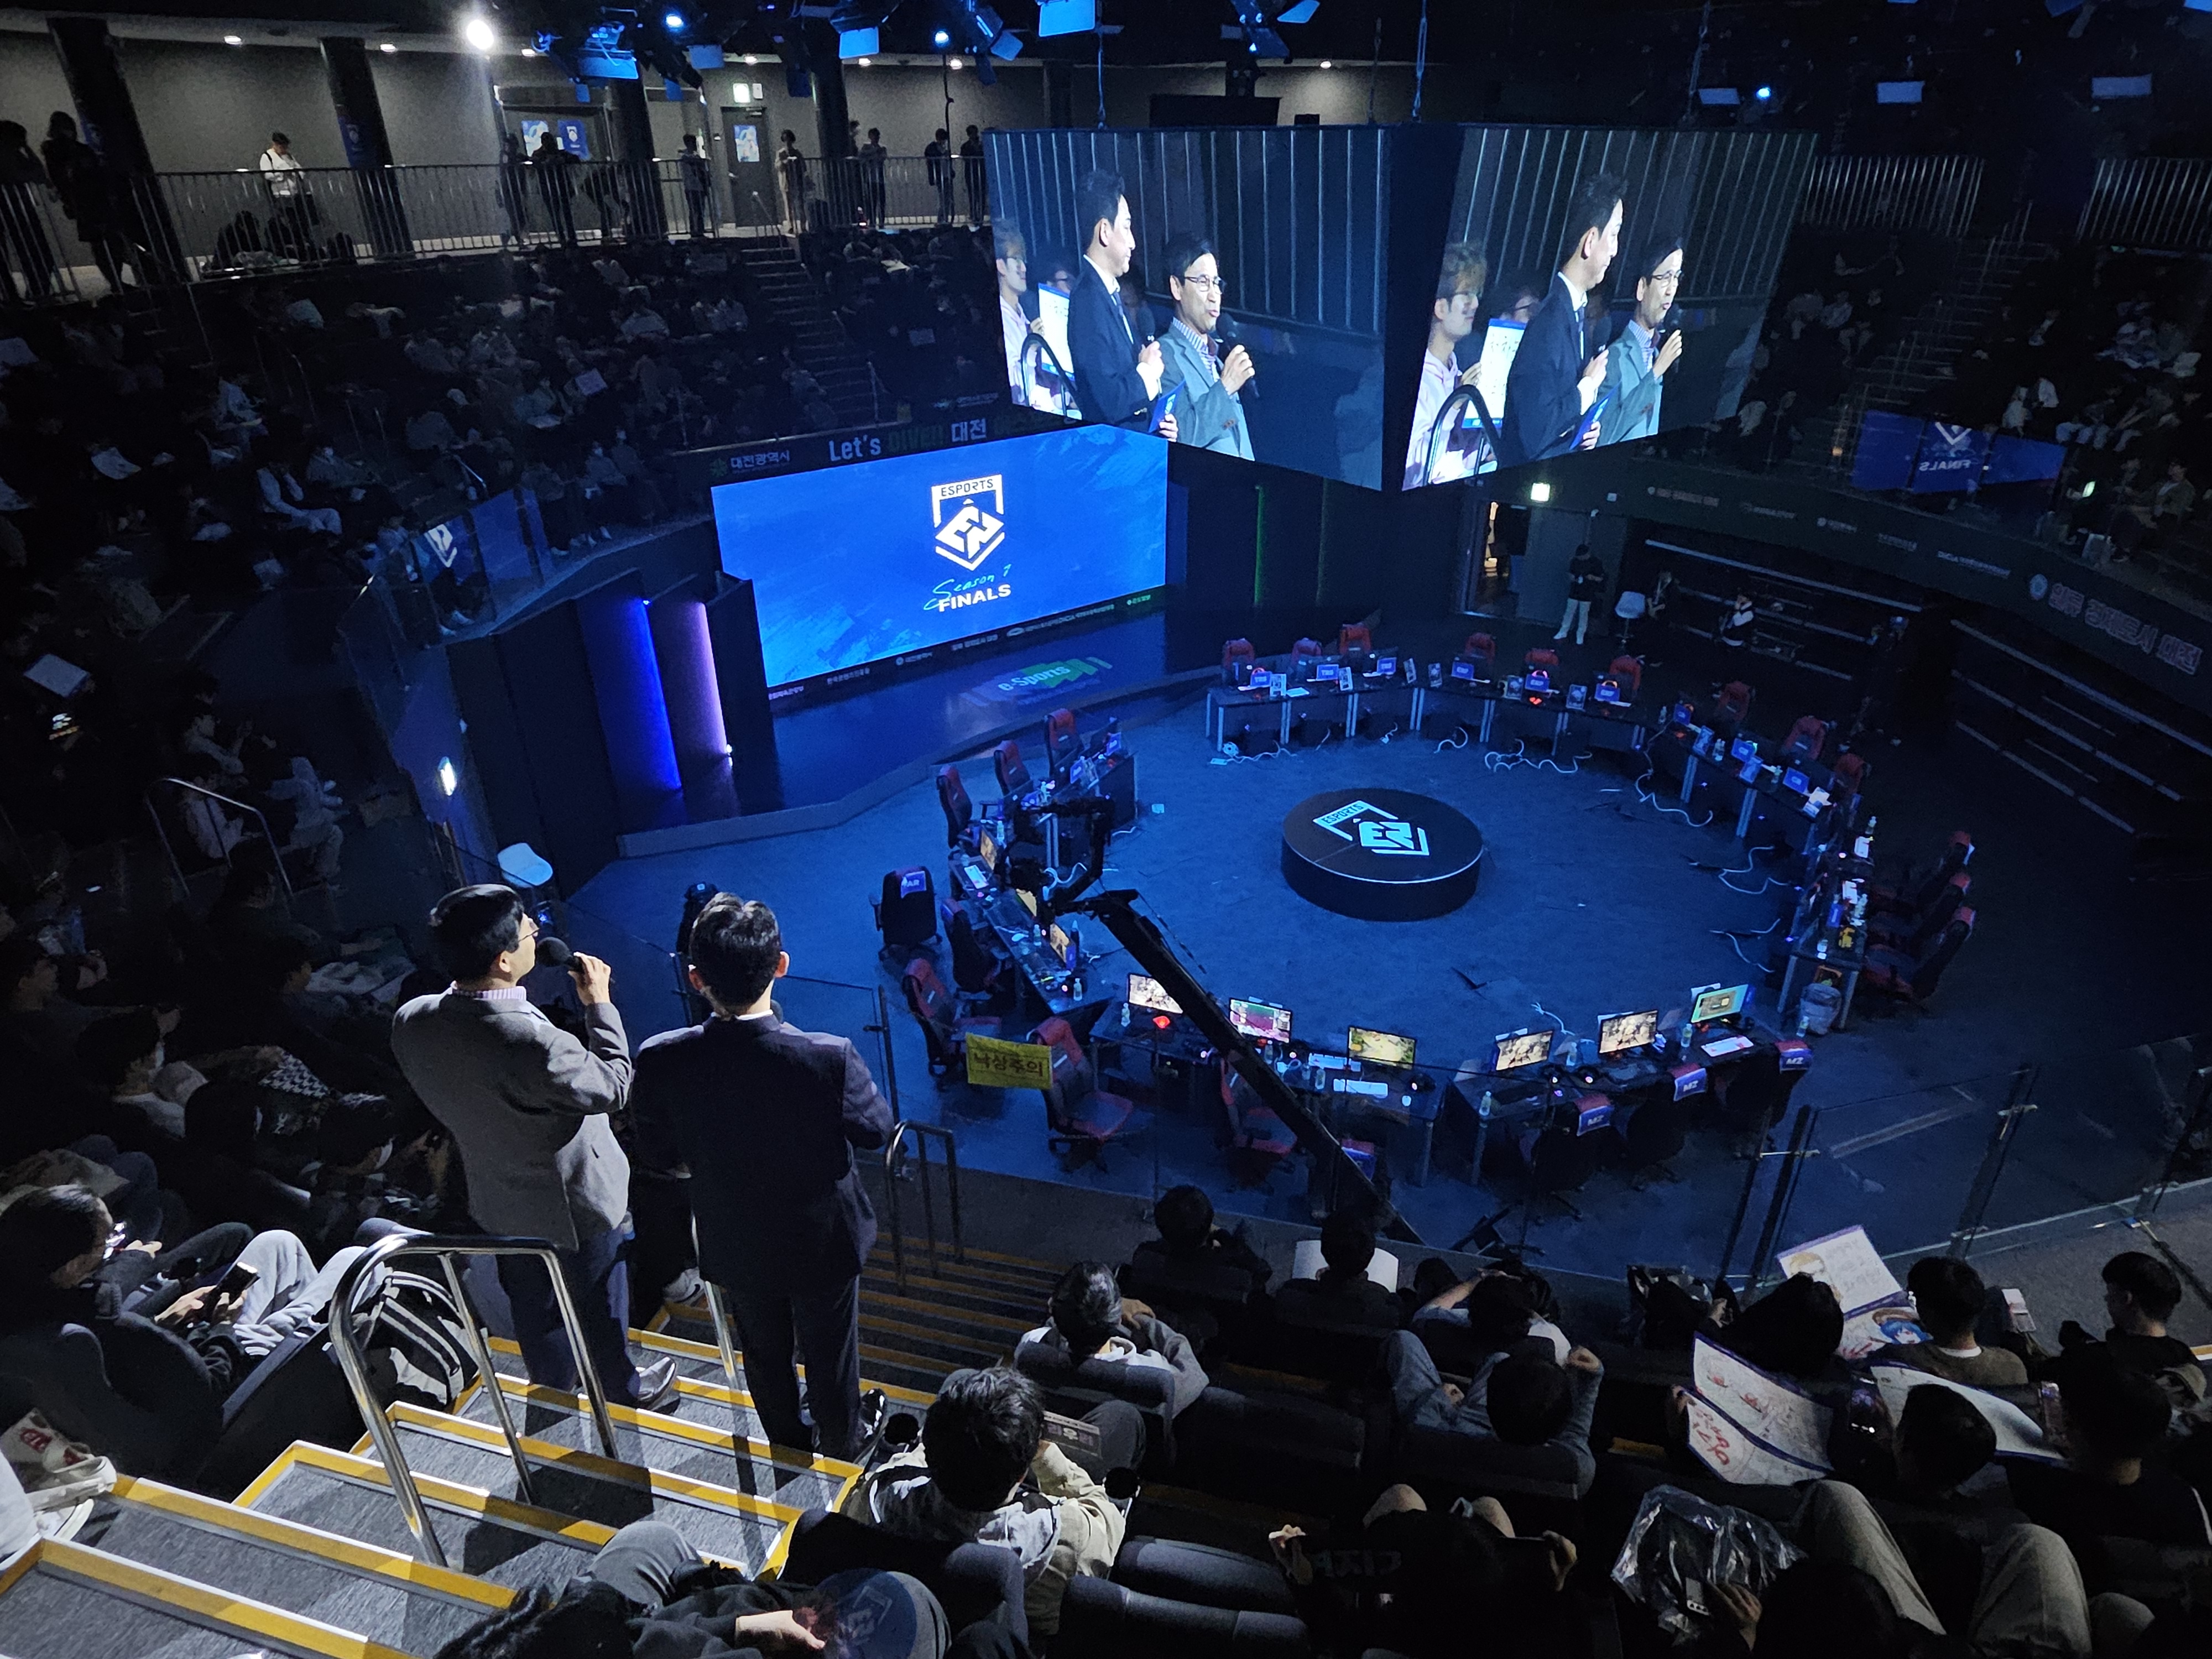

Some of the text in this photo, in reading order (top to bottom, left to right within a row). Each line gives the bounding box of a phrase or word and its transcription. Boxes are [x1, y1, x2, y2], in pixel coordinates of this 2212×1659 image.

[828, 434, 881, 462] Let's
[951, 418, 987, 442] 대전
[730, 450, 791, 468] 대전광역시
[941, 479, 994, 497] ESPORTS
[924, 575, 995, 611] Season
[938, 584, 1011, 612] FINALS
[998, 666, 1071, 691] e-Sports
[1321, 804, 1364, 824] ESPORTS
[973, 1052, 1044, 1077] 낙상주의
